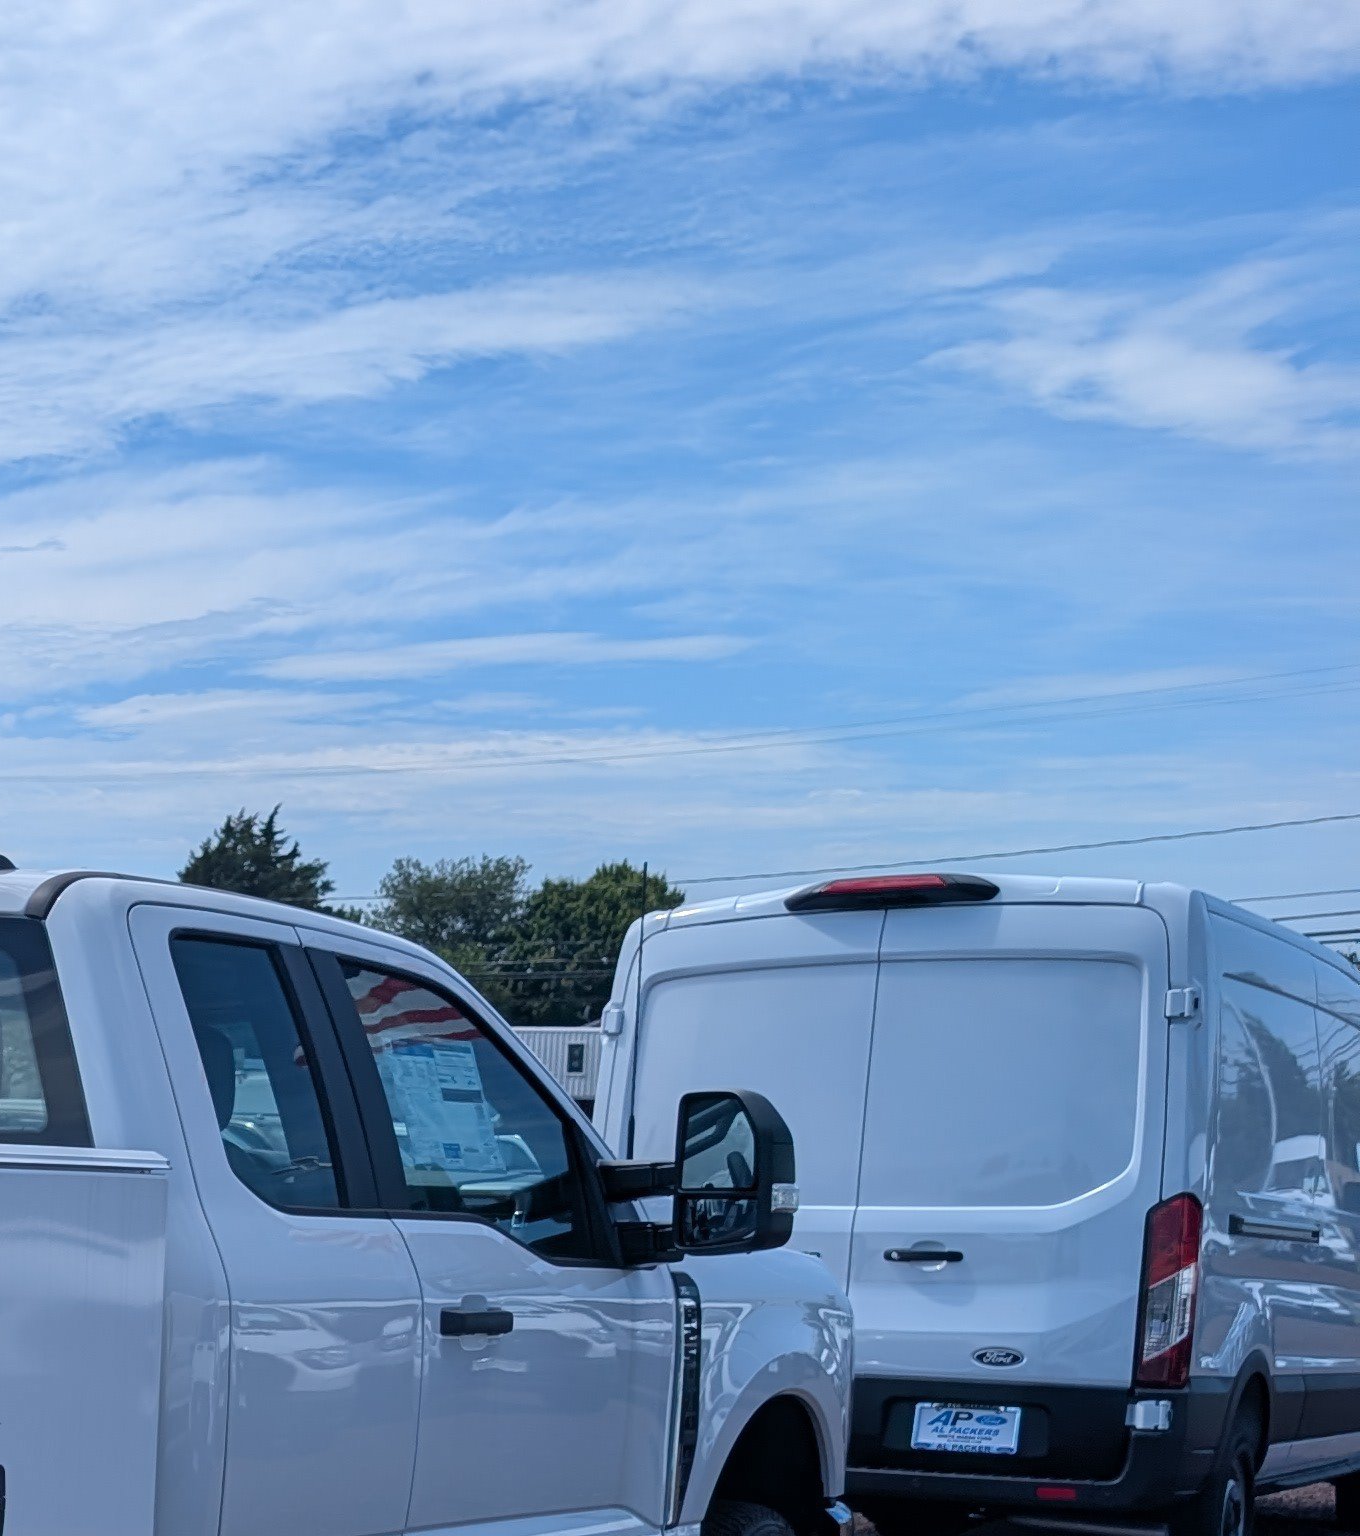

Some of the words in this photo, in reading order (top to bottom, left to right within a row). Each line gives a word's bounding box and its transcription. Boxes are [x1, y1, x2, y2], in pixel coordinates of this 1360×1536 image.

[927, 1411, 974, 1426] AP
[931, 1426, 945, 1434] AL
[948, 1427, 1000, 1436] PACKERS
